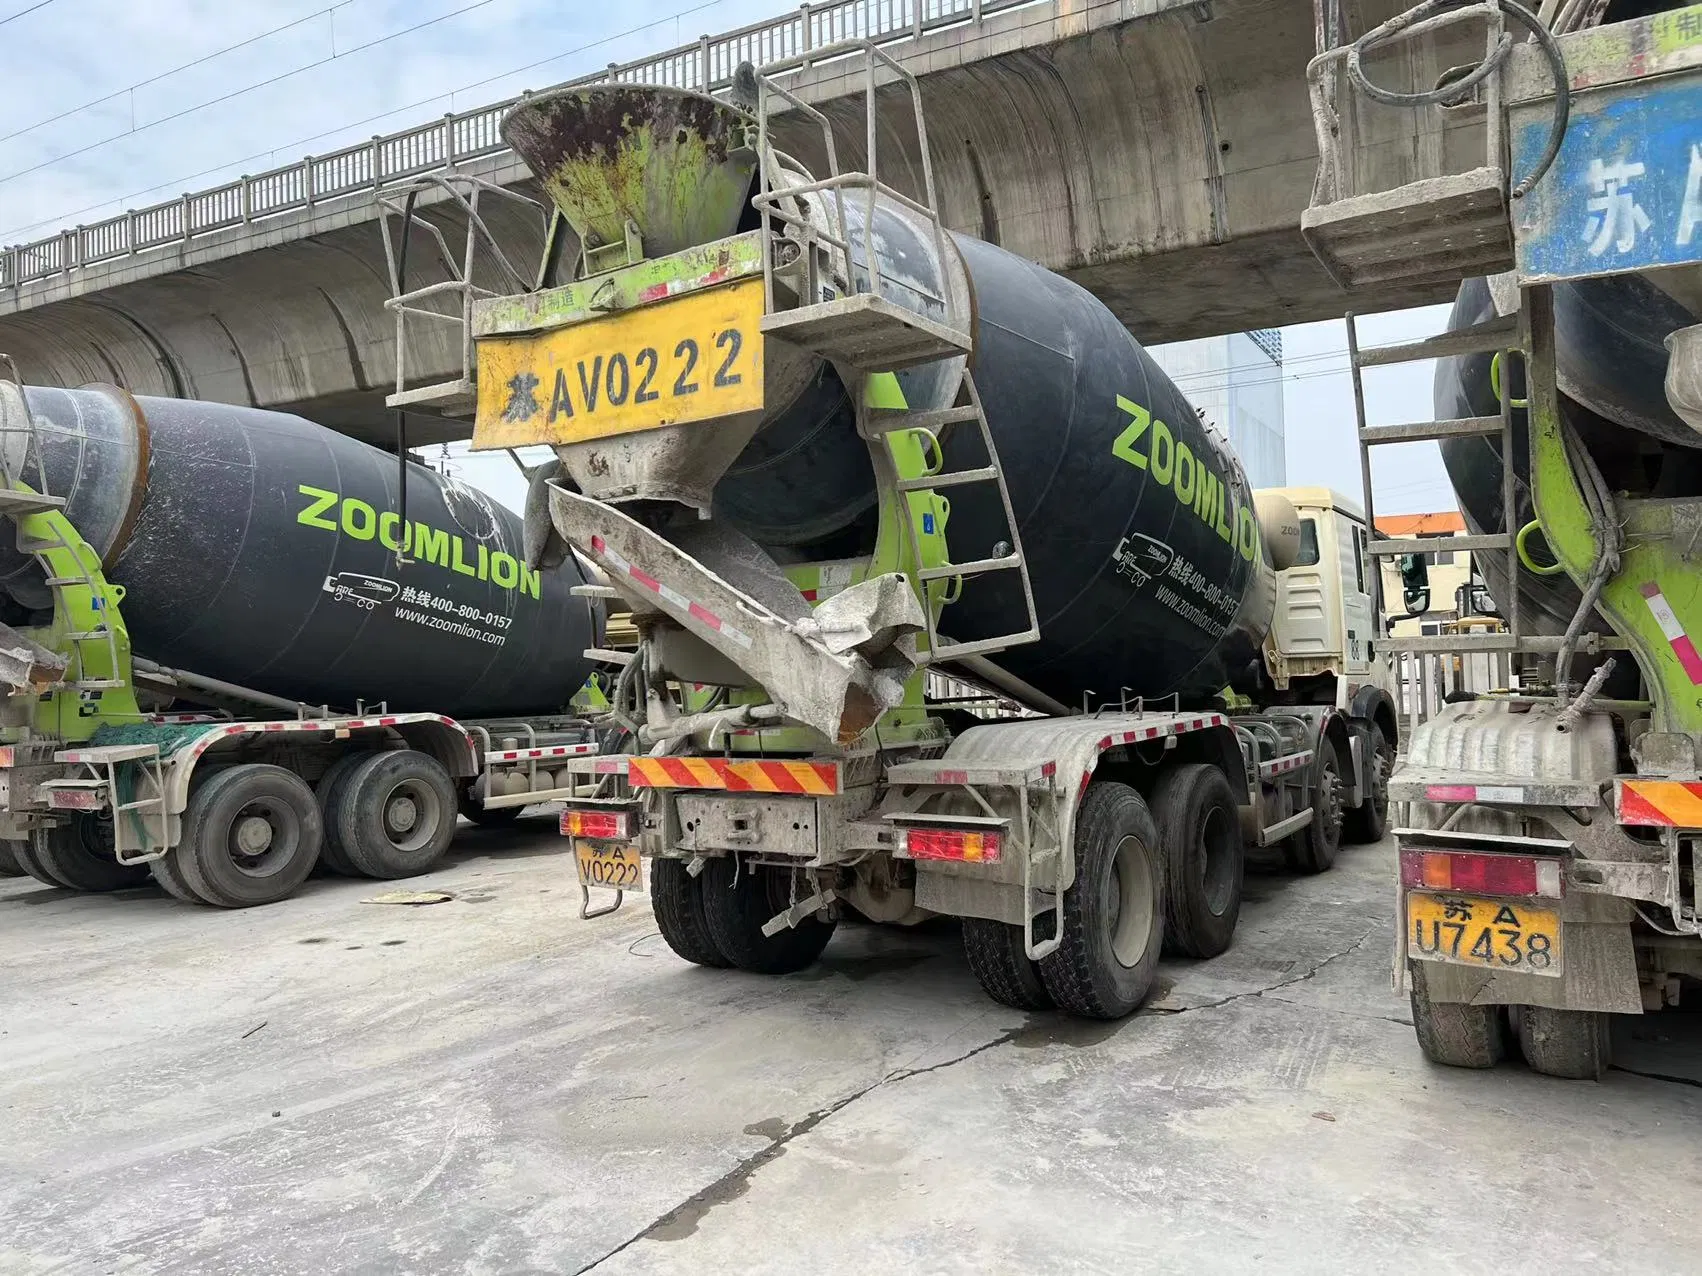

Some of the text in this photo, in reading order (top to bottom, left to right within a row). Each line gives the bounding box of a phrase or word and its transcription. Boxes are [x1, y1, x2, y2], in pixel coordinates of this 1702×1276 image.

[364, 580, 393, 593] ZOOMLION
[395, 607, 505, 646] www.zoomlion.com
[581, 859, 638, 885] V0222
[1416, 919, 1550, 969] U7438
